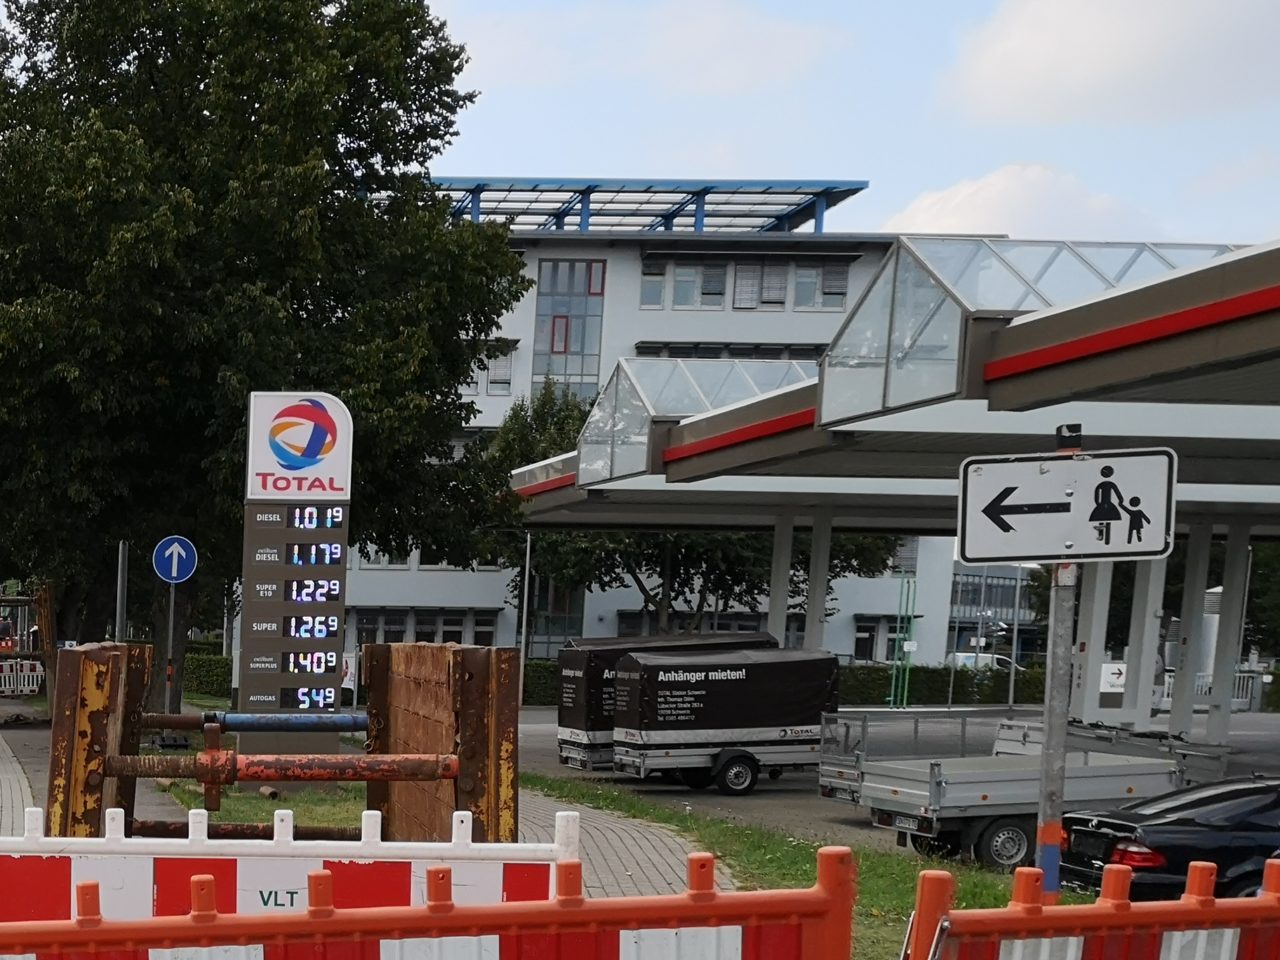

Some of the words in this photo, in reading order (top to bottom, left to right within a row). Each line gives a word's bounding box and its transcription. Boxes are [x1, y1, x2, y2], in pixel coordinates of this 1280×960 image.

[256, 473, 344, 492] TOTAL
[256, 513, 281, 522] DIESEL
[292, 580, 340, 602] 1.229
[252, 623, 277, 631] SUPER
[290, 616, 338, 638] 1.269
[657, 670, 706, 683] Anhänger
[708, 668, 746, 680] mieten!
[259, 890, 299, 907] VLT
